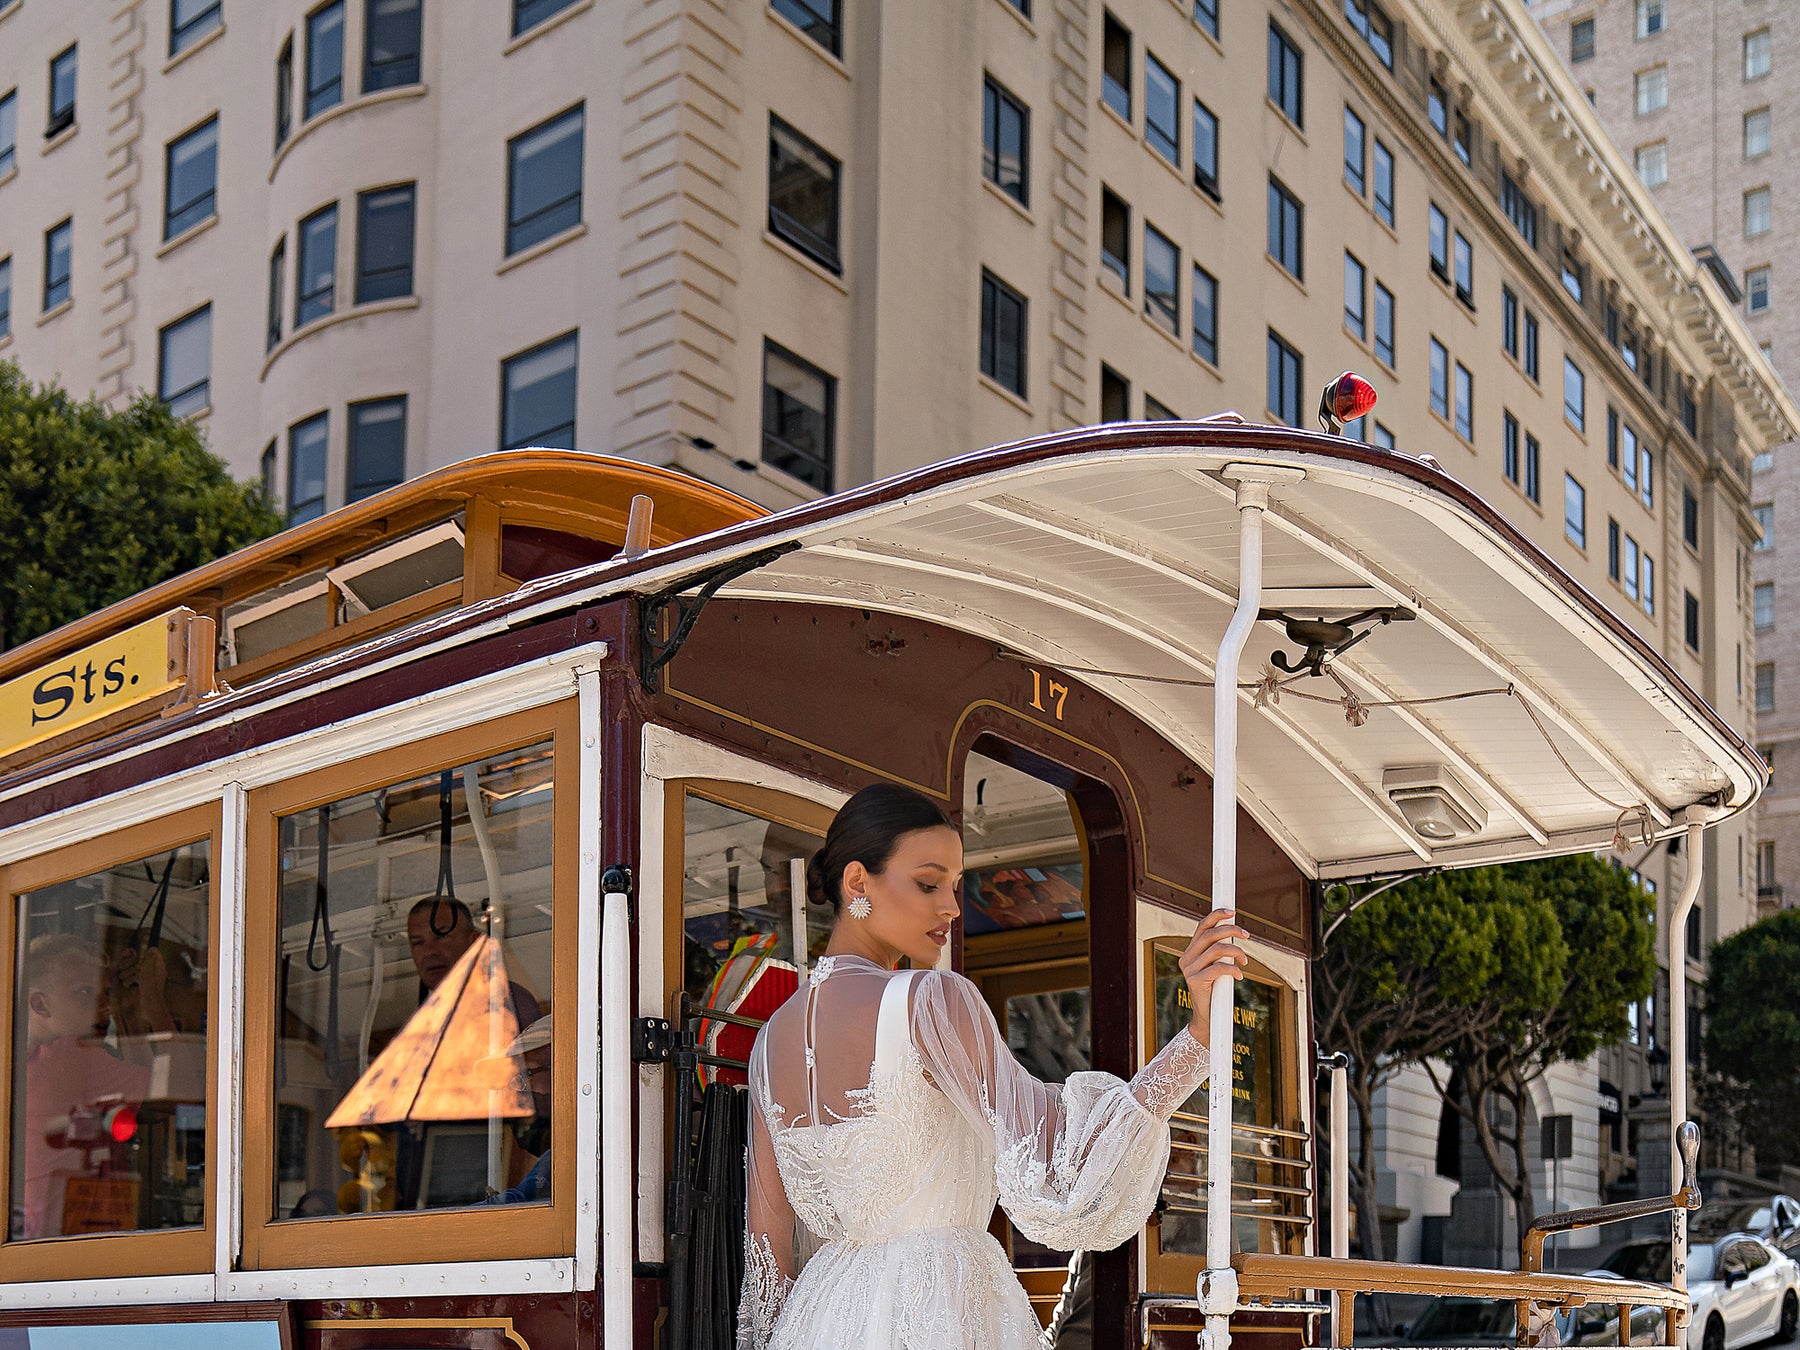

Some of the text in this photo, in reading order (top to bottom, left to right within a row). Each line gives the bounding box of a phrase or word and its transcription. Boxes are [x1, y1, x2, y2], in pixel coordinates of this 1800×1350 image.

[31, 655, 139, 727] Sts.
[1028, 668, 1069, 720] 17
[1241, 1008, 1257, 1028] WAY
